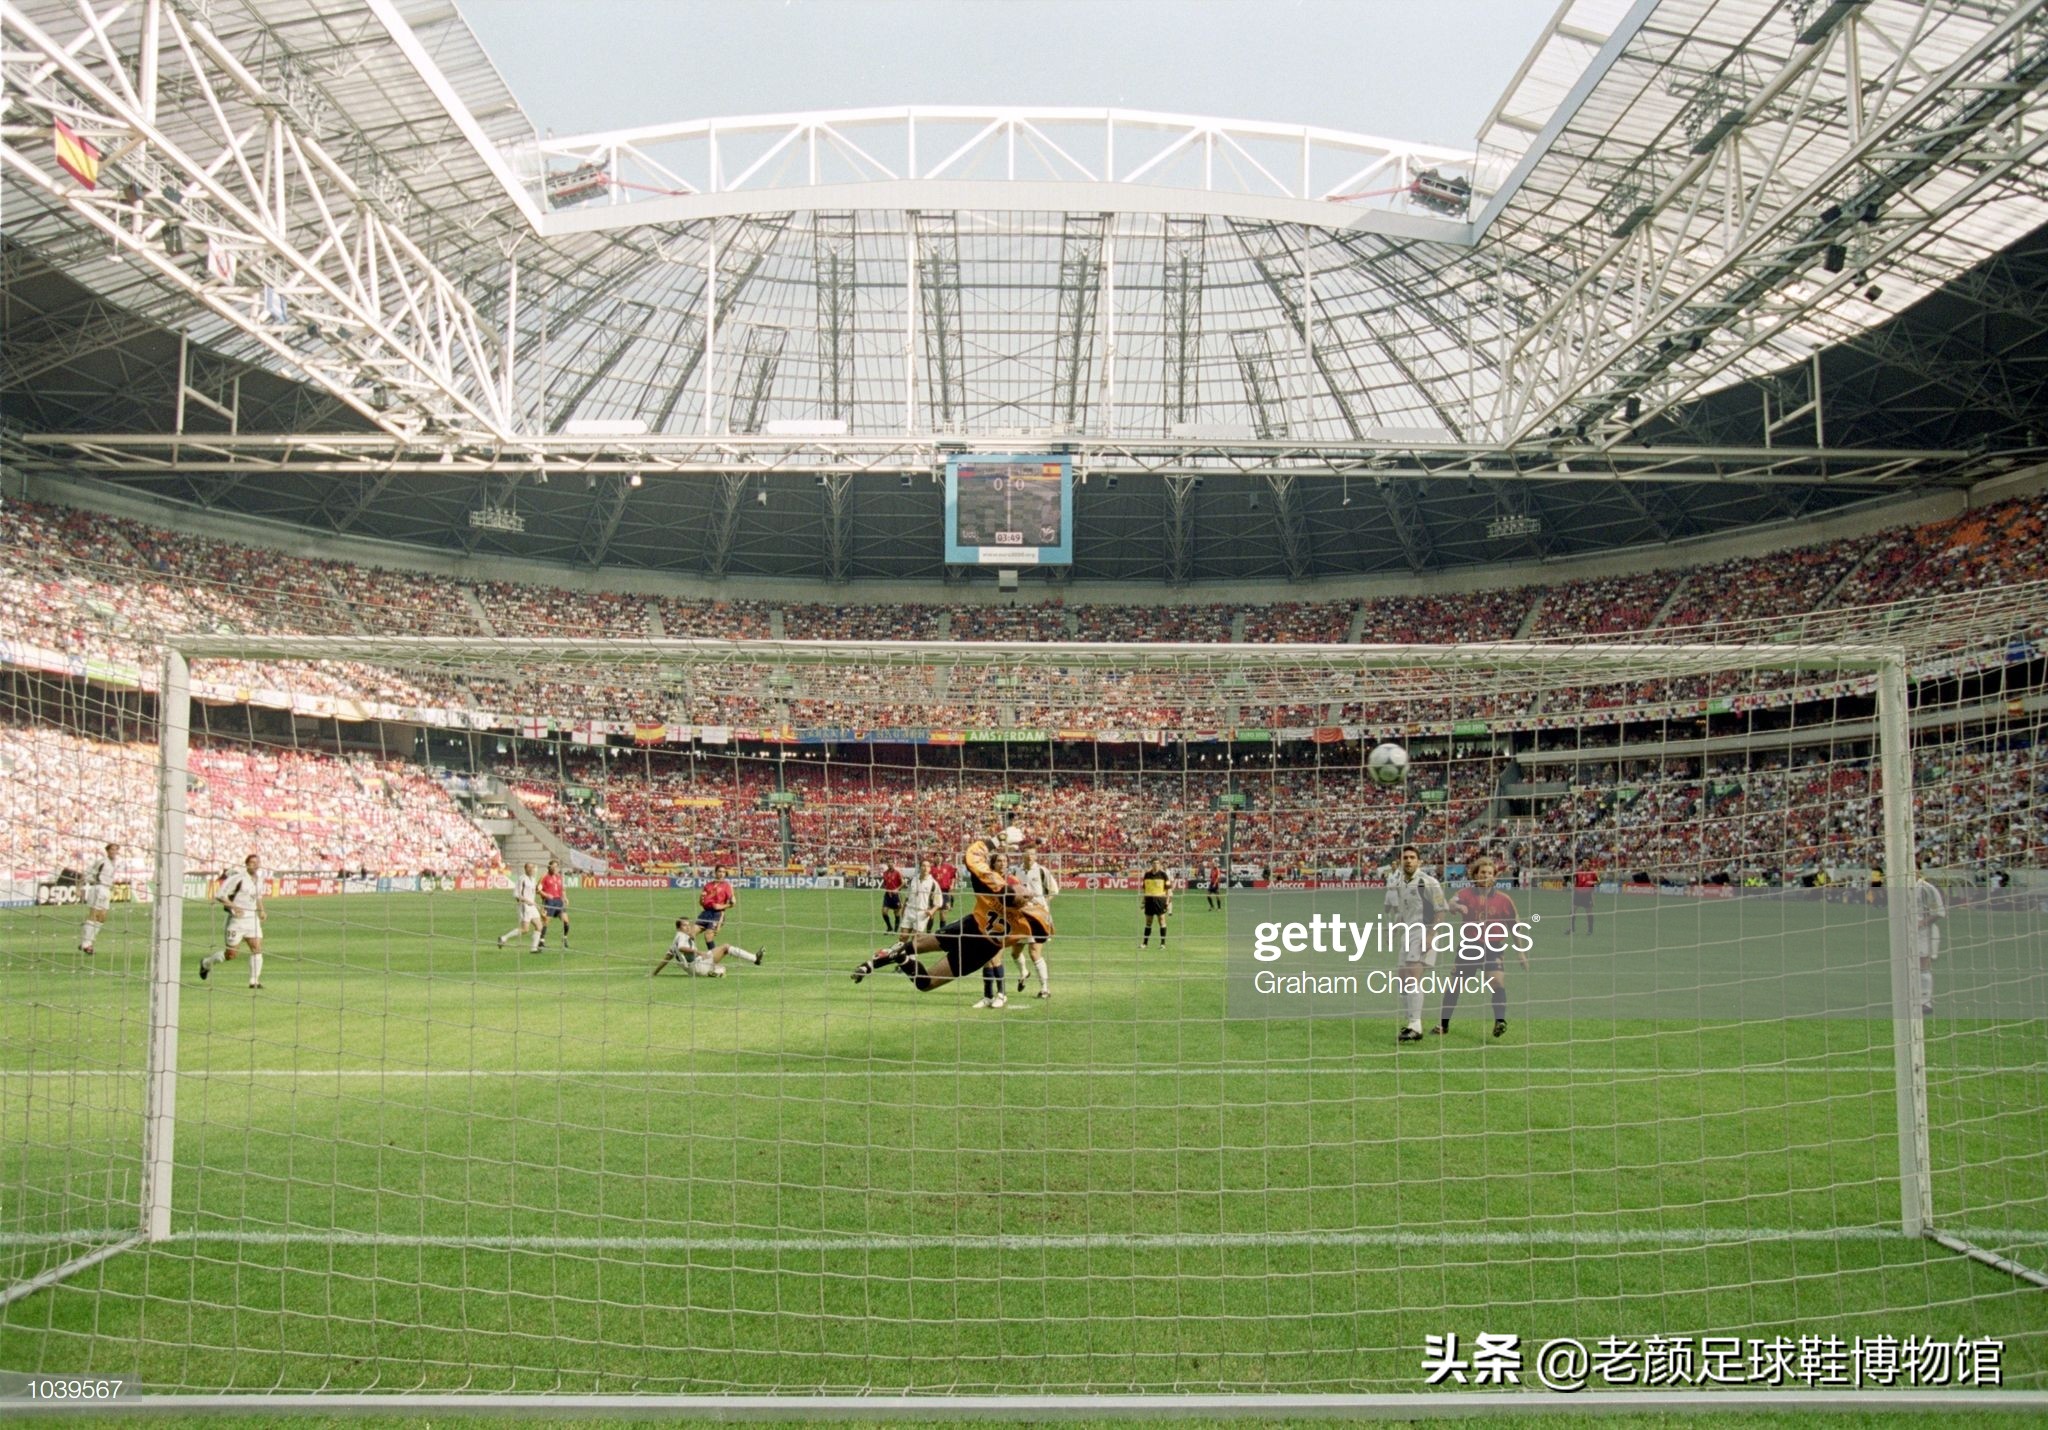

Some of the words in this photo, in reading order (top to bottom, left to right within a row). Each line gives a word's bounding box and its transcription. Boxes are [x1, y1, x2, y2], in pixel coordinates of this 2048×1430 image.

[970, 731, 1045, 742] AMSTERDAM
[598, 877, 668, 888] McDonald's
[760, 876, 814, 889] PHILIPS
[1104, 878, 1128, 889] JVC
